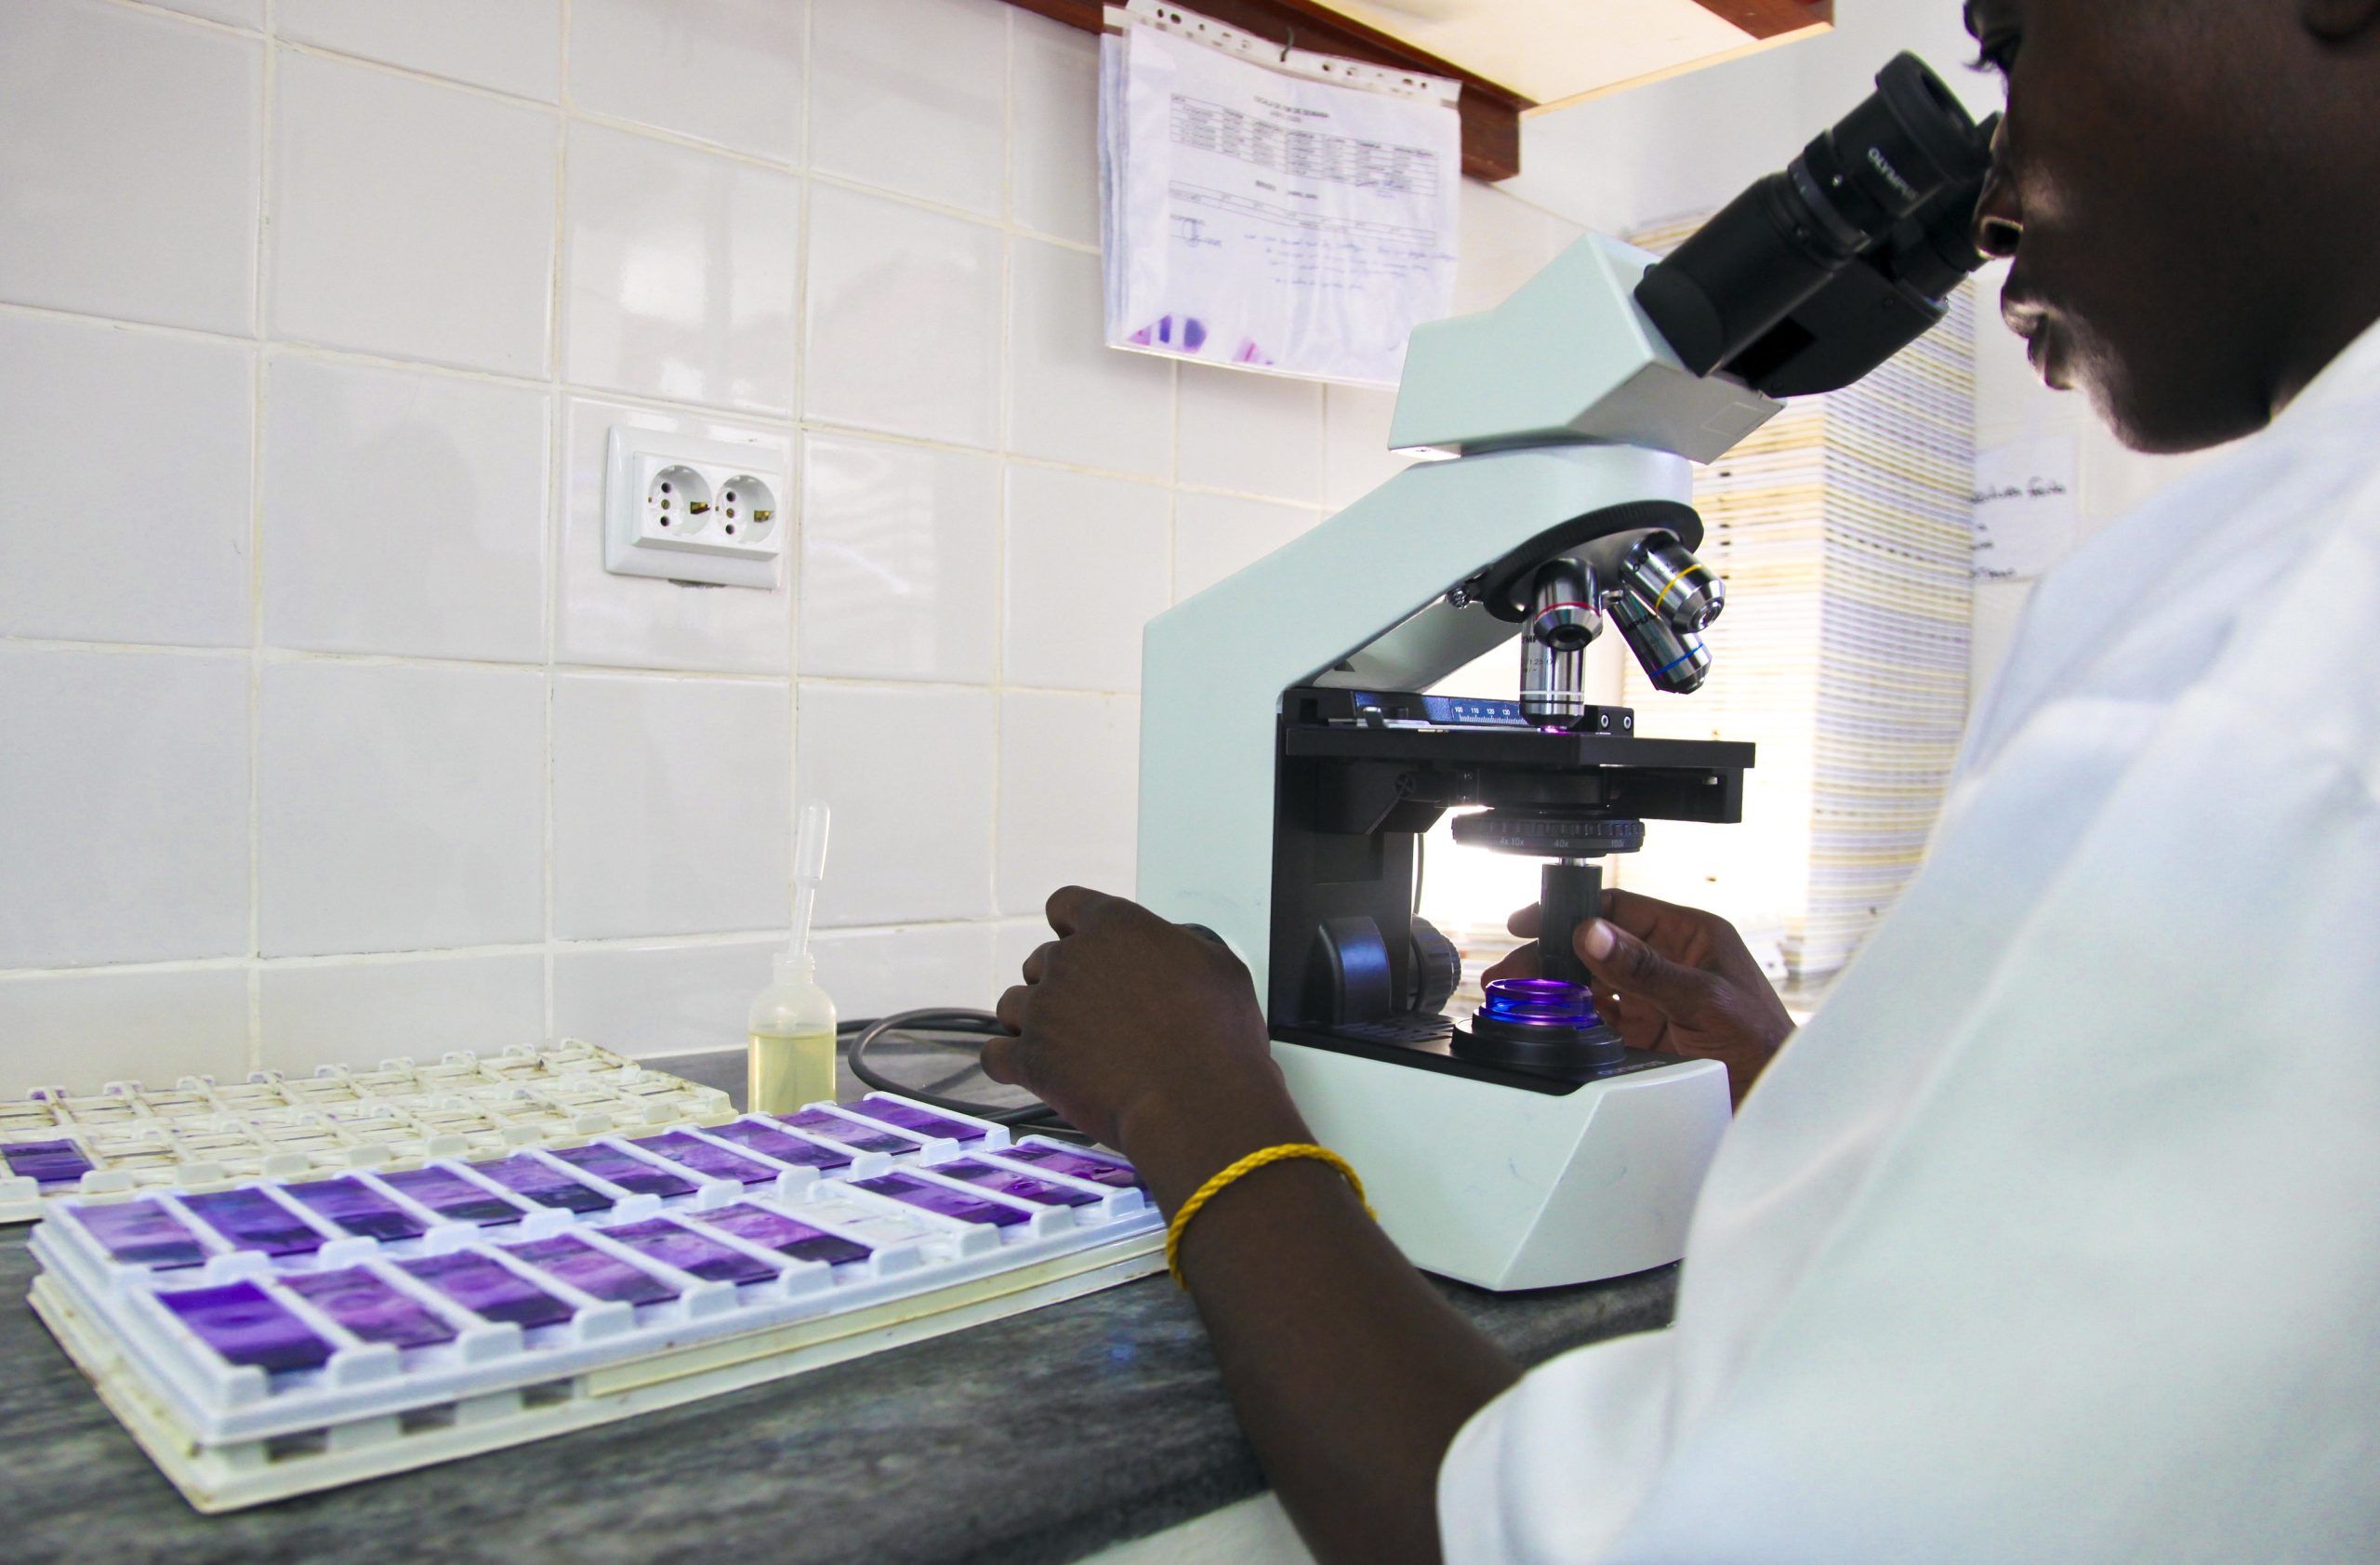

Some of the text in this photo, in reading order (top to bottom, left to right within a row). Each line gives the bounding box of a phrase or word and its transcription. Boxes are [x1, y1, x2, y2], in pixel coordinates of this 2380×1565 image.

[1868, 147, 1920, 202] OLYMPUS
[1512, 838, 1525, 846] 10x
[1554, 840, 1568, 848] 40x
